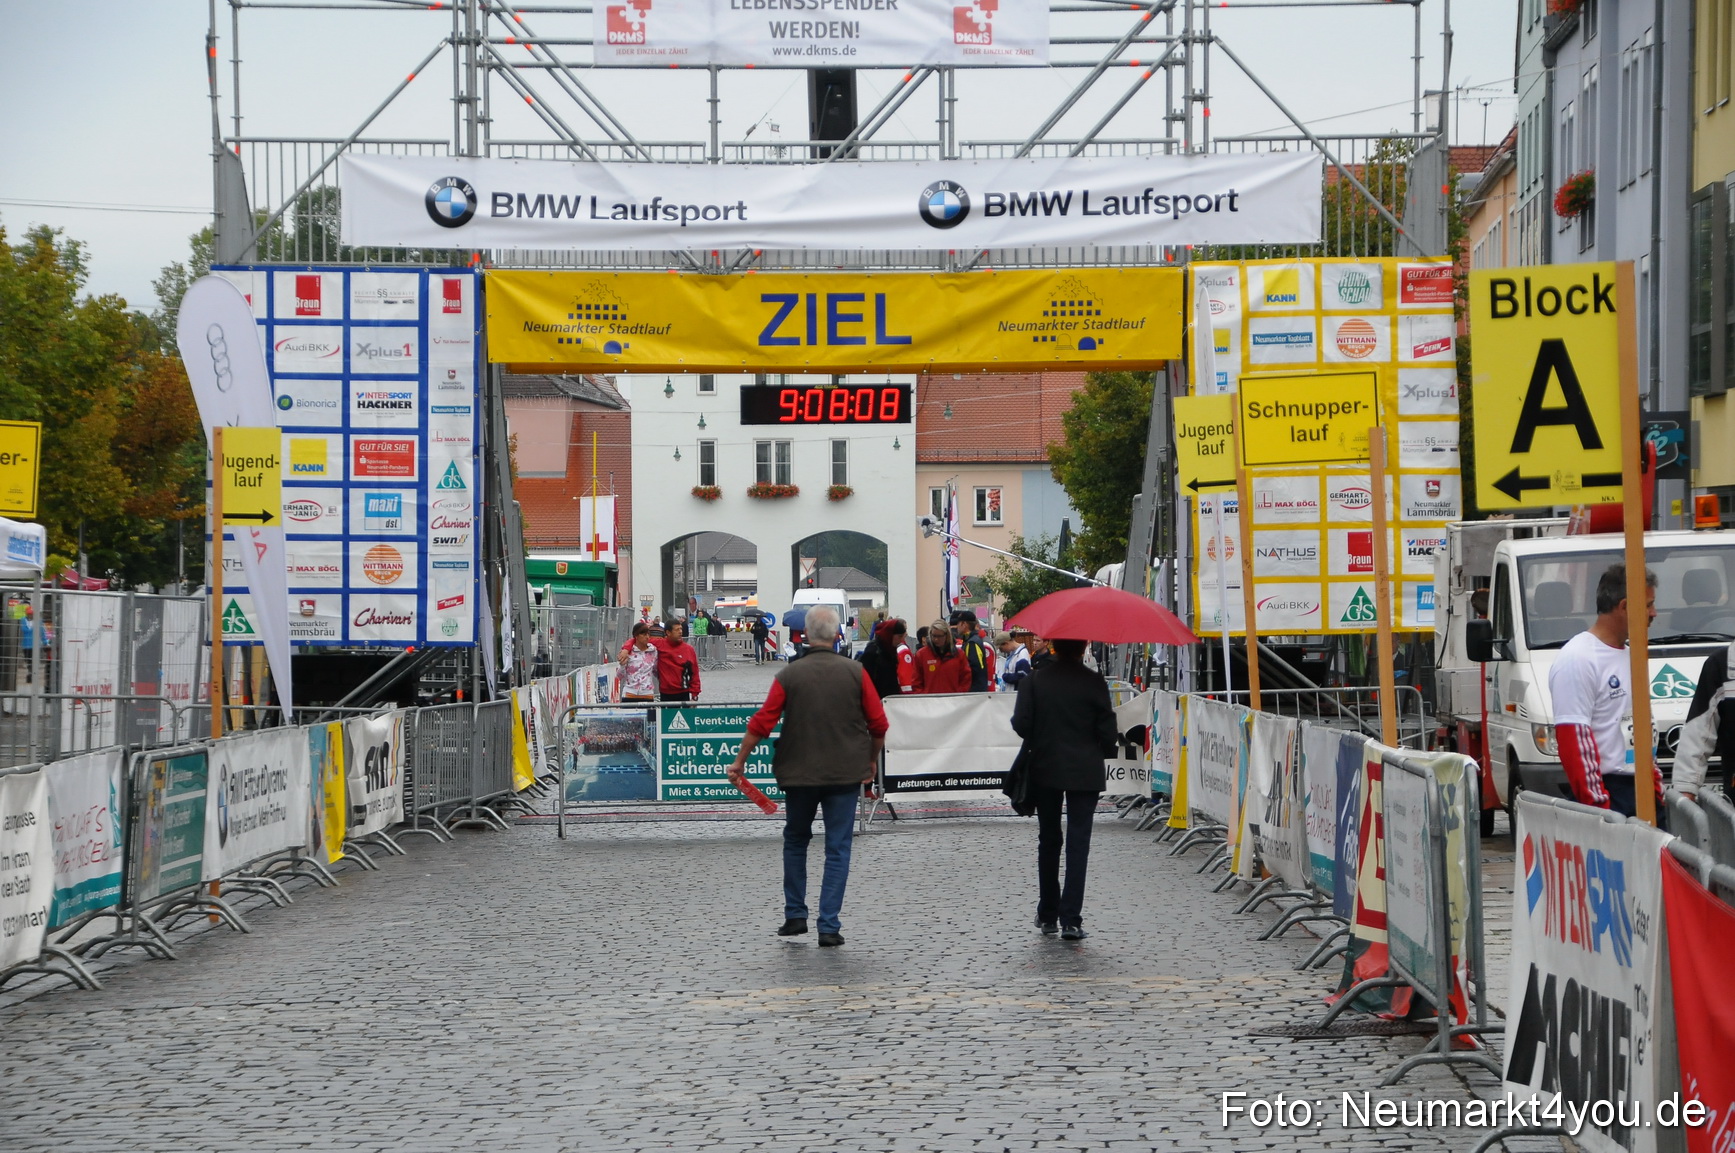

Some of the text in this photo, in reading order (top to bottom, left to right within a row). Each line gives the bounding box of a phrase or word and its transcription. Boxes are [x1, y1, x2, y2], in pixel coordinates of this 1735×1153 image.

[769, 21, 860, 39] WERDEN!
[609, 31, 644, 43] DKMS
[956, 32, 990, 43] DKMS
[773, 45, 857, 56] www.dkms.de
[963, 47, 981, 55] JEDER
[1016, 47, 1034, 55] ZÄHLT
[491, 191, 748, 227] BMW Laufsport
[984, 188, 1239, 220] BMW Laufsport
[1425, 270, 1440, 278] FÜR
[1199, 276, 1235, 288] Xplus1
[1266, 294, 1296, 302] KANN
[1490, 273, 1616, 319] Block
[758, 292, 912, 346] ZIEL
[998, 317, 1146, 332] Neumarkter Stadtlauf
[523, 320, 672, 336] Neumarkter Stadtlauf
[355, 343, 413, 360] Xplus1
[1403, 384, 1455, 400] Xplus1
[1510, 338, 1604, 453] A
[297, 398, 337, 408] Bionorica
[357, 400, 412, 409] HACKNER
[779, 388, 900, 422] 9:08:08
[1248, 400, 1369, 420] Schnupper-
[1291, 424, 1329, 442] lauf
[360, 442, 409, 451] GUT FÜR SIE!
[1197, 440, 1225, 456] lauf
[293, 464, 324, 472] KANN
[234, 472, 263, 487] lauf
[368, 497, 399, 512] maxi
[1407, 508, 1456, 517] Lammsbräu
[385, 519, 397, 528] dsl
[1257, 547, 1316, 560] NATHUS
[1266, 601, 1309, 610] Audi BKK
[354, 608, 413, 627] Charivari
[291, 627, 335, 636] mmsbräu
[702, 742, 713, 756] &
[897, 777, 1002, 789] Leistungen, die verbinden
[669, 788, 691, 796] Miet
[694, 788, 702, 796] &
[704, 787, 738, 796] Service
